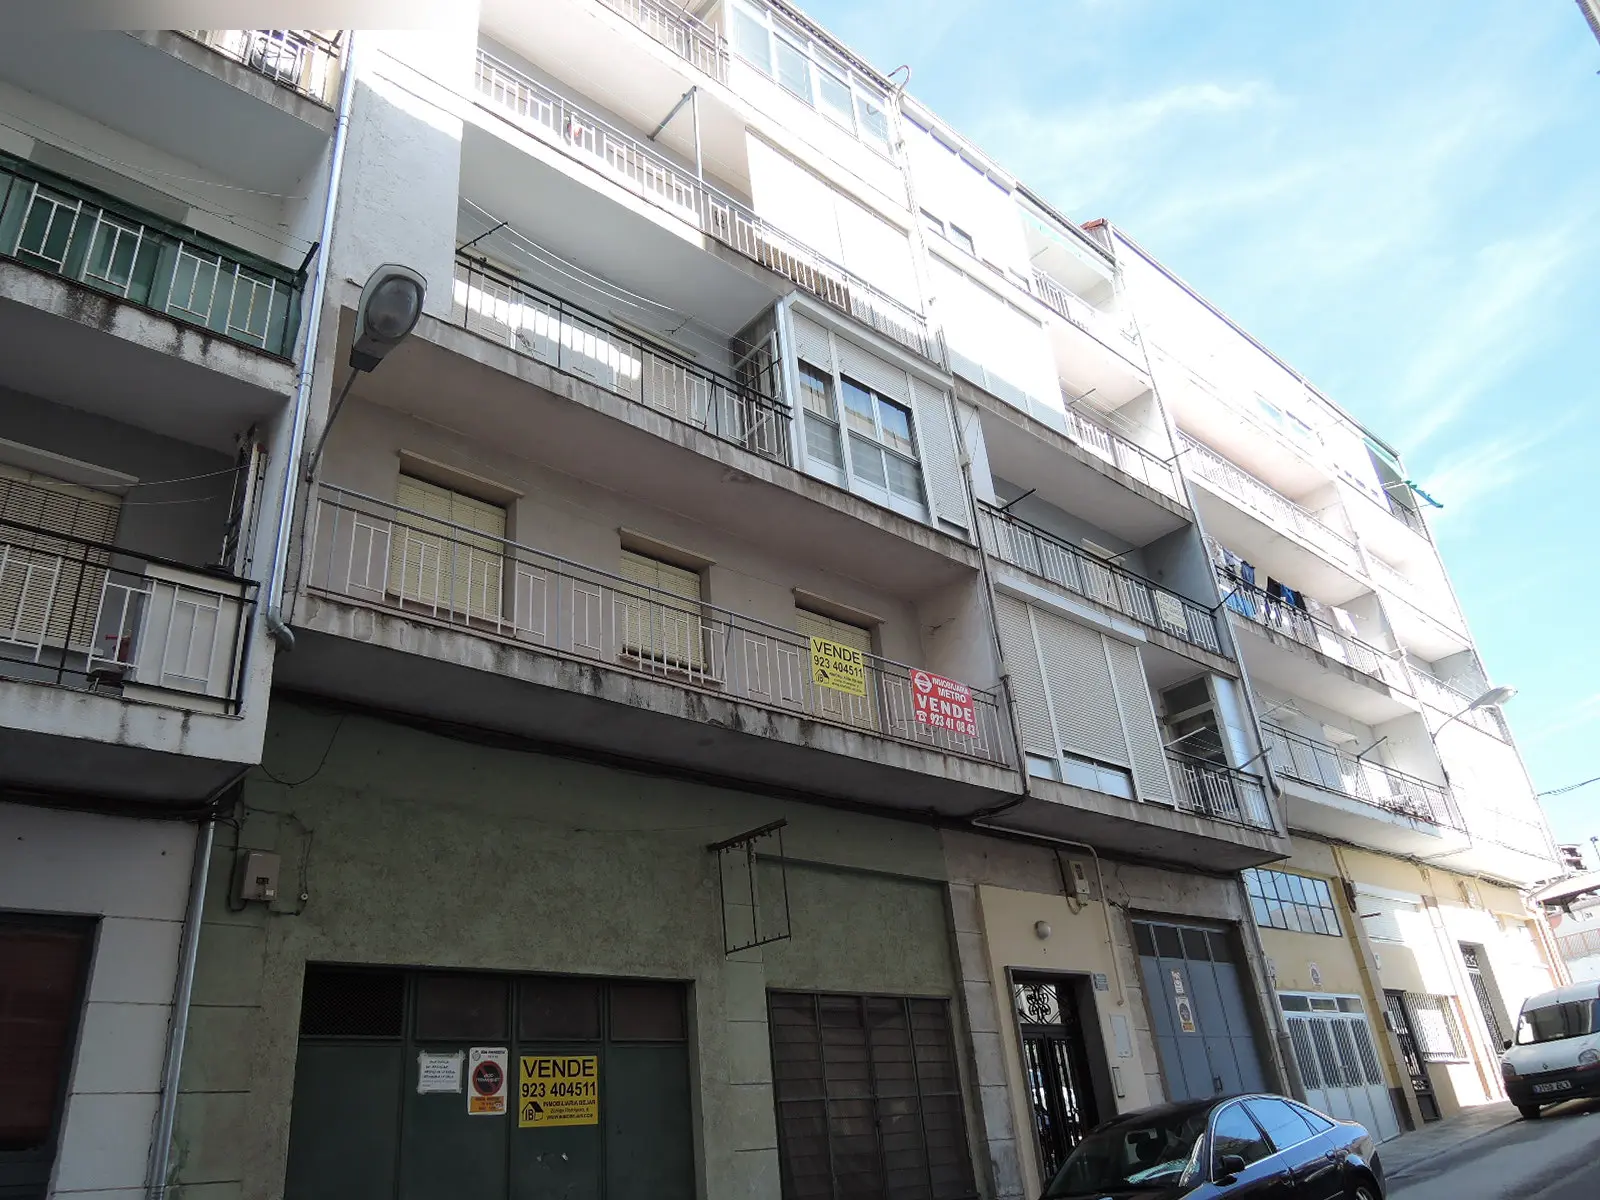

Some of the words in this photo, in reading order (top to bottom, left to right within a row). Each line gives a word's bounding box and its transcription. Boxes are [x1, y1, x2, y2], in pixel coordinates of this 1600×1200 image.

[813, 639, 861, 665] VENDE
[813, 655, 830, 669] 923
[833, 661, 863, 678] 404511
[937, 687, 967, 703] METRO
[916, 693, 973, 722] VENDE
[930, 712, 944, 726] 923
[946, 718, 954, 729] 41
[956, 720, 965, 732] 08
[523, 1059, 594, 1077] VENDE
[522, 1083, 546, 1097] 923
[550, 1081, 596, 1097] 404511
